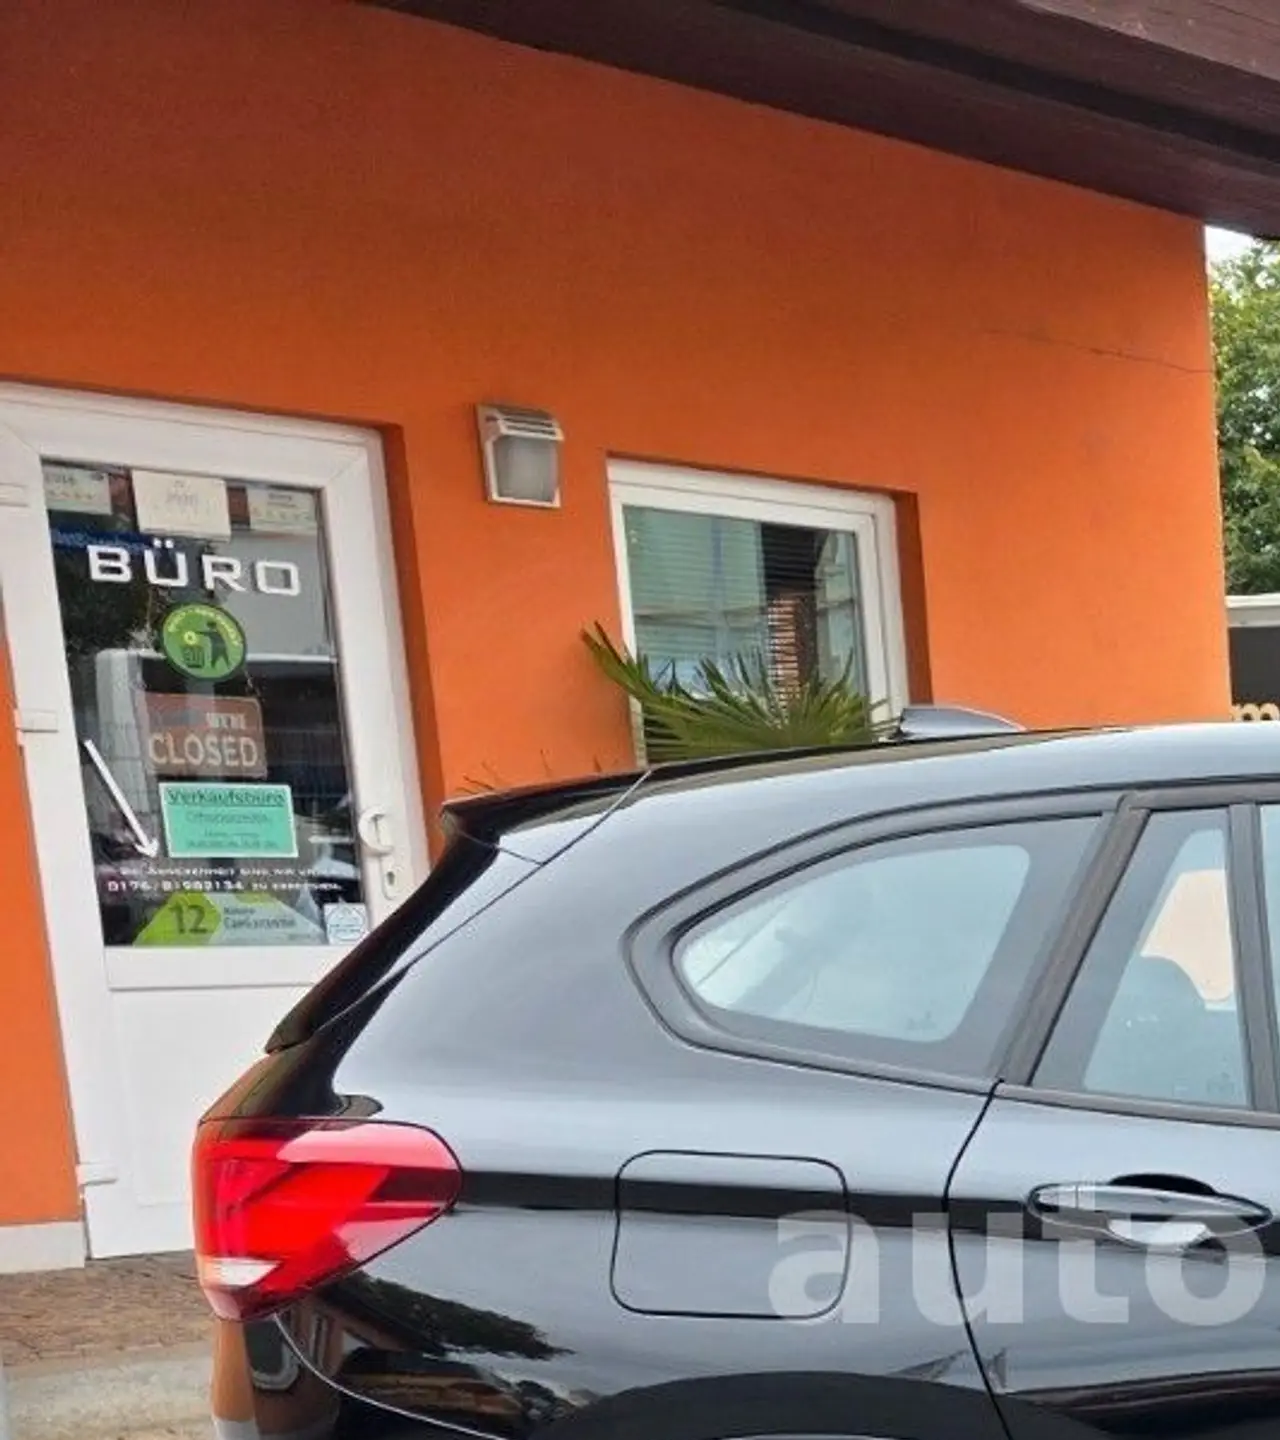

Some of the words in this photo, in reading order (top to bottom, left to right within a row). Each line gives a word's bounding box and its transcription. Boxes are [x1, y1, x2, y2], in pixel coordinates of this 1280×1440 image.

[87, 539, 300, 596] BÜRO
[149, 731, 258, 767] CLOSED
[170, 904, 209, 934] 12
